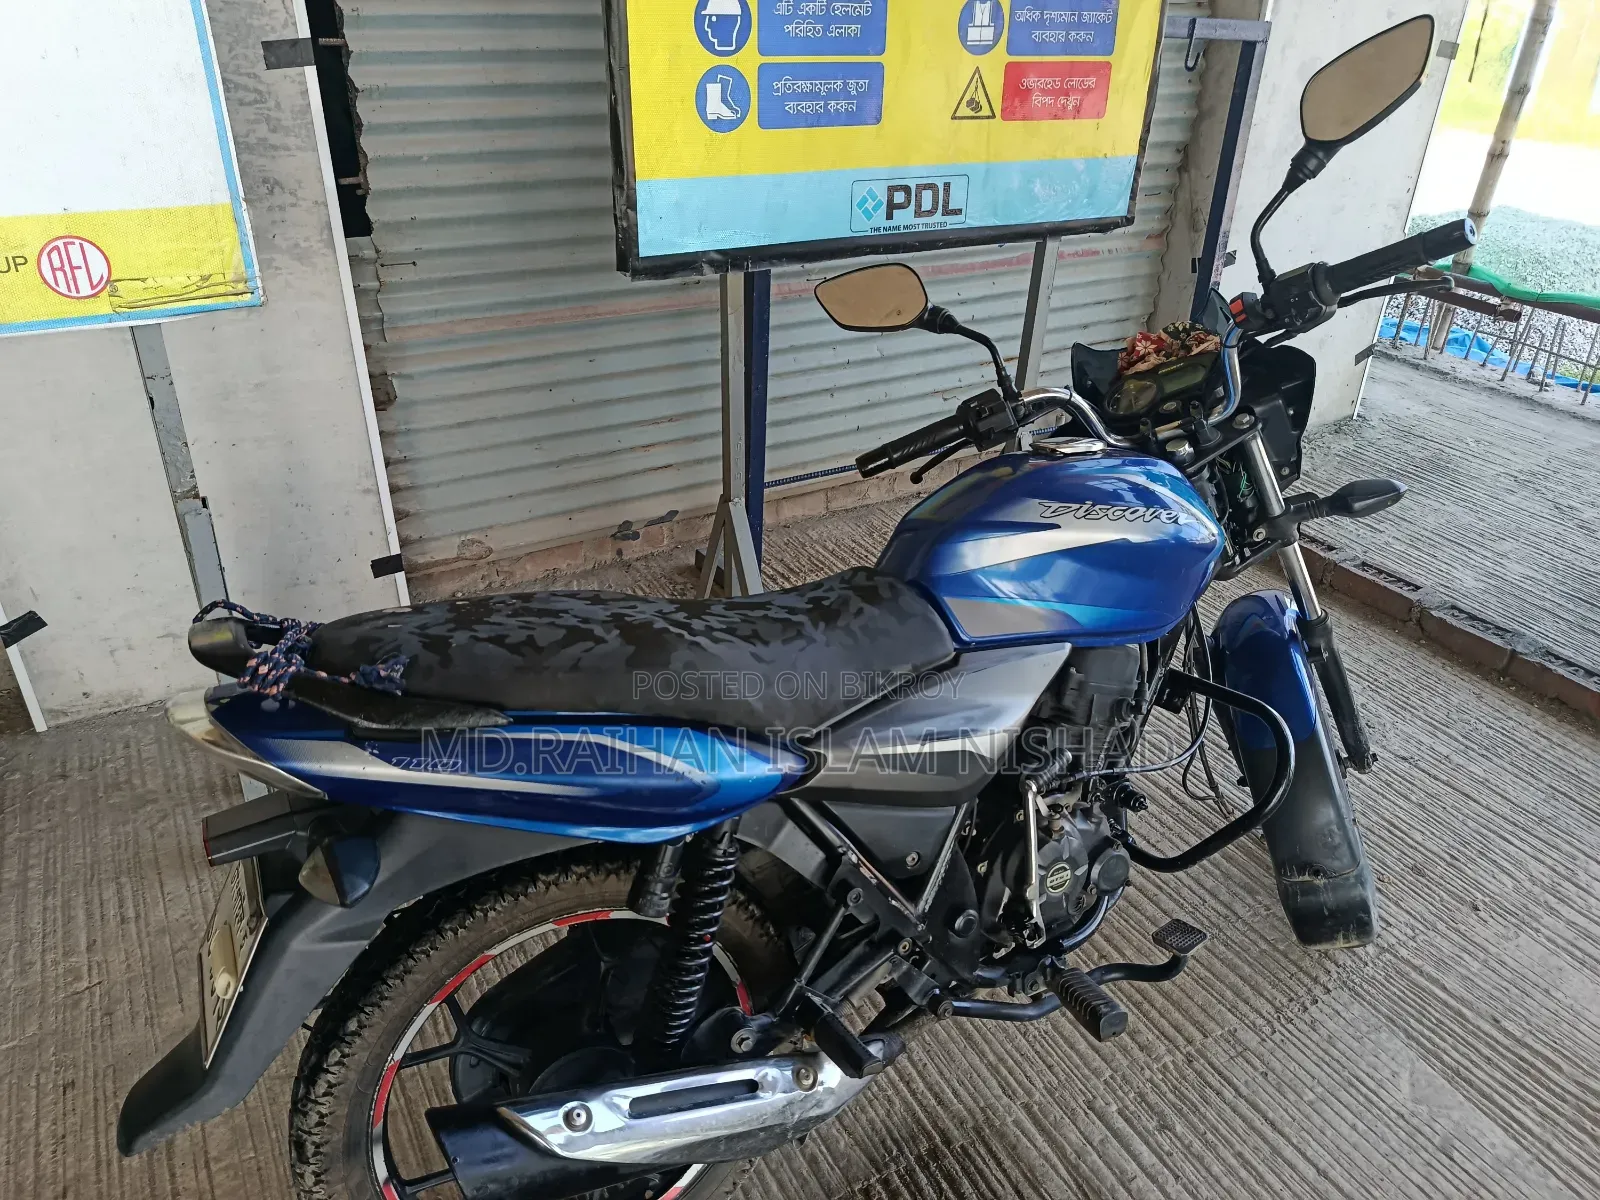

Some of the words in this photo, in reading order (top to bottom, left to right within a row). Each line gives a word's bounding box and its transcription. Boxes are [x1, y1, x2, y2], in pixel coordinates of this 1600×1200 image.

[830, 0, 872, 17] হেলমেট
[1014, 6, 1041, 23] অধিক
[1081, 9, 1114, 24] জ্যাকেট
[784, 19, 823, 38] পরিহিত
[827, 24, 861, 38] এলাকা
[1031, 30, 1066, 43] ব্যবহার
[1068, 31, 1094, 43] করুন
[773, 76, 843, 96] প্রতিরক্ষামূলক
[846, 80, 869, 95] জুতা
[1063, 77, 1096, 90] লোডের
[784, 101, 824, 115] ব্যবহার
[828, 100, 857, 113] করুন
[1032, 92, 1055, 108] বিপদ
[886, 181, 963, 221] PDL
[883, 225, 902, 233] NAME
[903, 223, 921, 231] MOST
[921, 221, 948, 230] TRUSTED
[46, 241, 105, 294] RFL
[1038, 501, 1199, 526] Discover
